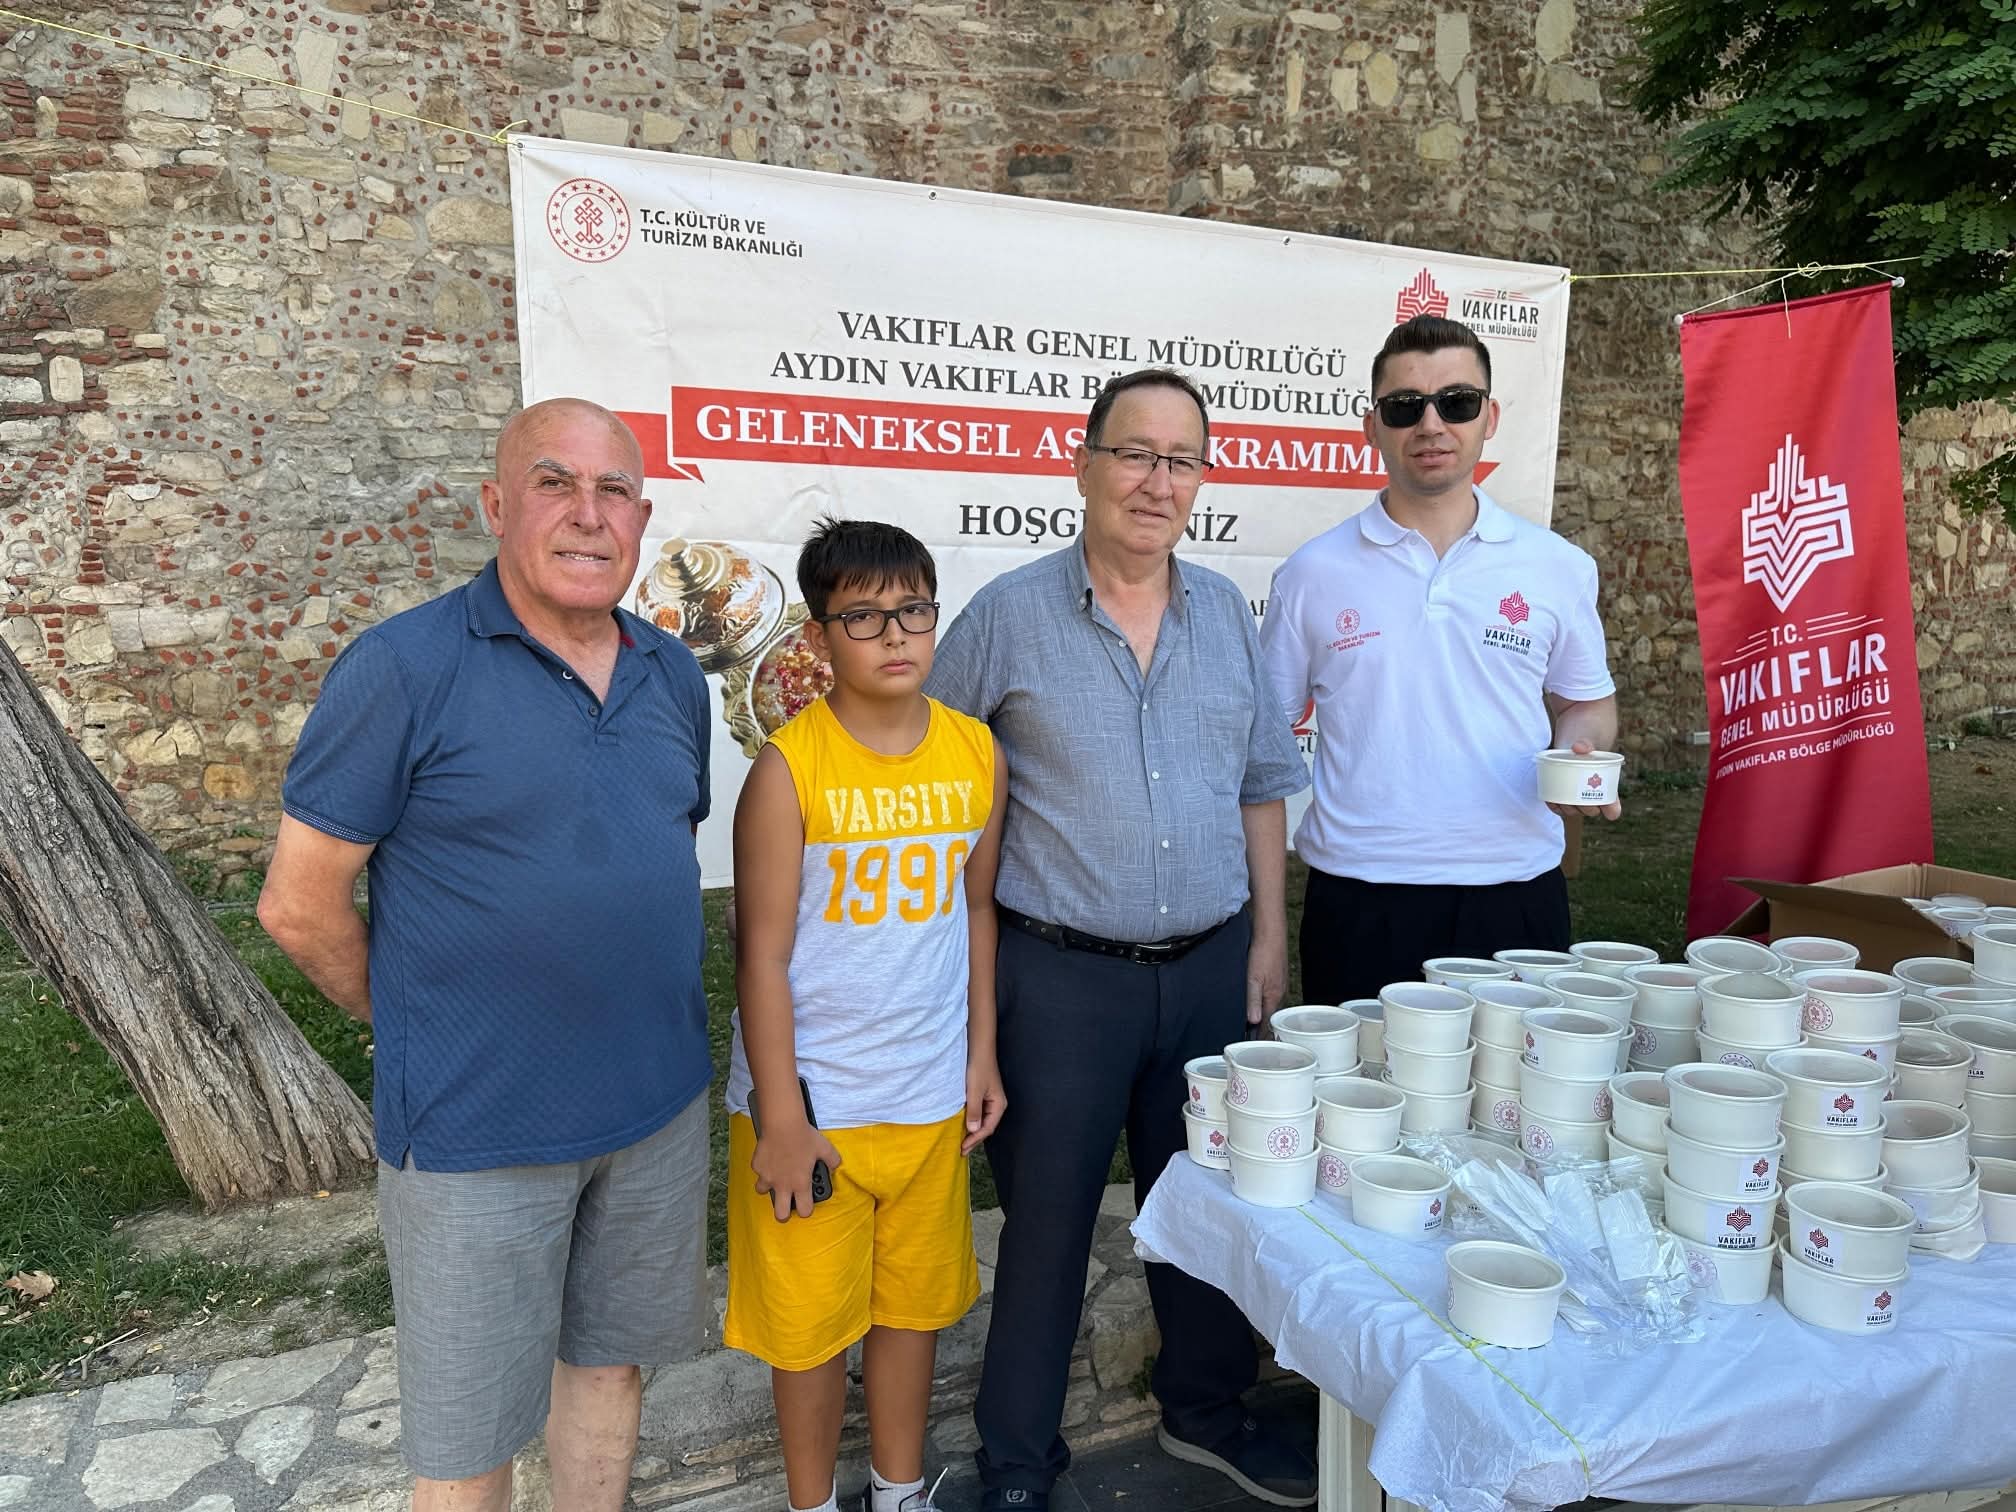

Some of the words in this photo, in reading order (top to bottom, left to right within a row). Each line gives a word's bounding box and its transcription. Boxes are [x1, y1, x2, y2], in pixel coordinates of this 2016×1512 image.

[640, 209, 670, 225] T.C.
[674, 210, 740, 232] KÜLTÜR
[745, 219, 766, 235] VE
[640, 228, 707, 248] TURİZM
[713, 235, 803, 258] BAKANLIĞI
[1462, 299, 1539, 324] VAKIFLAR
[837, 311, 1016, 352] VAKIFLAR
[1026, 328, 1137, 362] GENEL
[1147, 335, 1347, 377] MÜDÜRLÜĞÜ
[1463, 321, 1486, 333] ENEL
[1488, 322, 1538, 338] MÜDÜRLÜĞÜ
[770, 351, 888, 385] AYDIN
[899, 361, 1070, 398] VAKIFLAR
[1200, 380, 1371, 418] MÜDÜRLÜĞ
[695, 404, 1020, 458] GELENEKSEL
[1485, 628, 1531, 649] VAKIFLAR
[1771, 623, 1804, 647] T.C.
[1719, 633, 1889, 716] VAKIFLAR
[1721, 717, 1754, 749] GENEL
[1761, 678, 1890, 732] MÜDÜRLÜĞÜ
[1735, 750, 1787, 771] VAKIFLAR
[1789, 740, 1832, 759] BÖLGE
[1832, 721, 1895, 749] MÜDÜRLÜĞÜ
[825, 780, 973, 834] VARSITY
[1827, 1115, 1858, 1123] VAKIFLAR
[1718, 1236, 1757, 1245] VAKIFLAR
